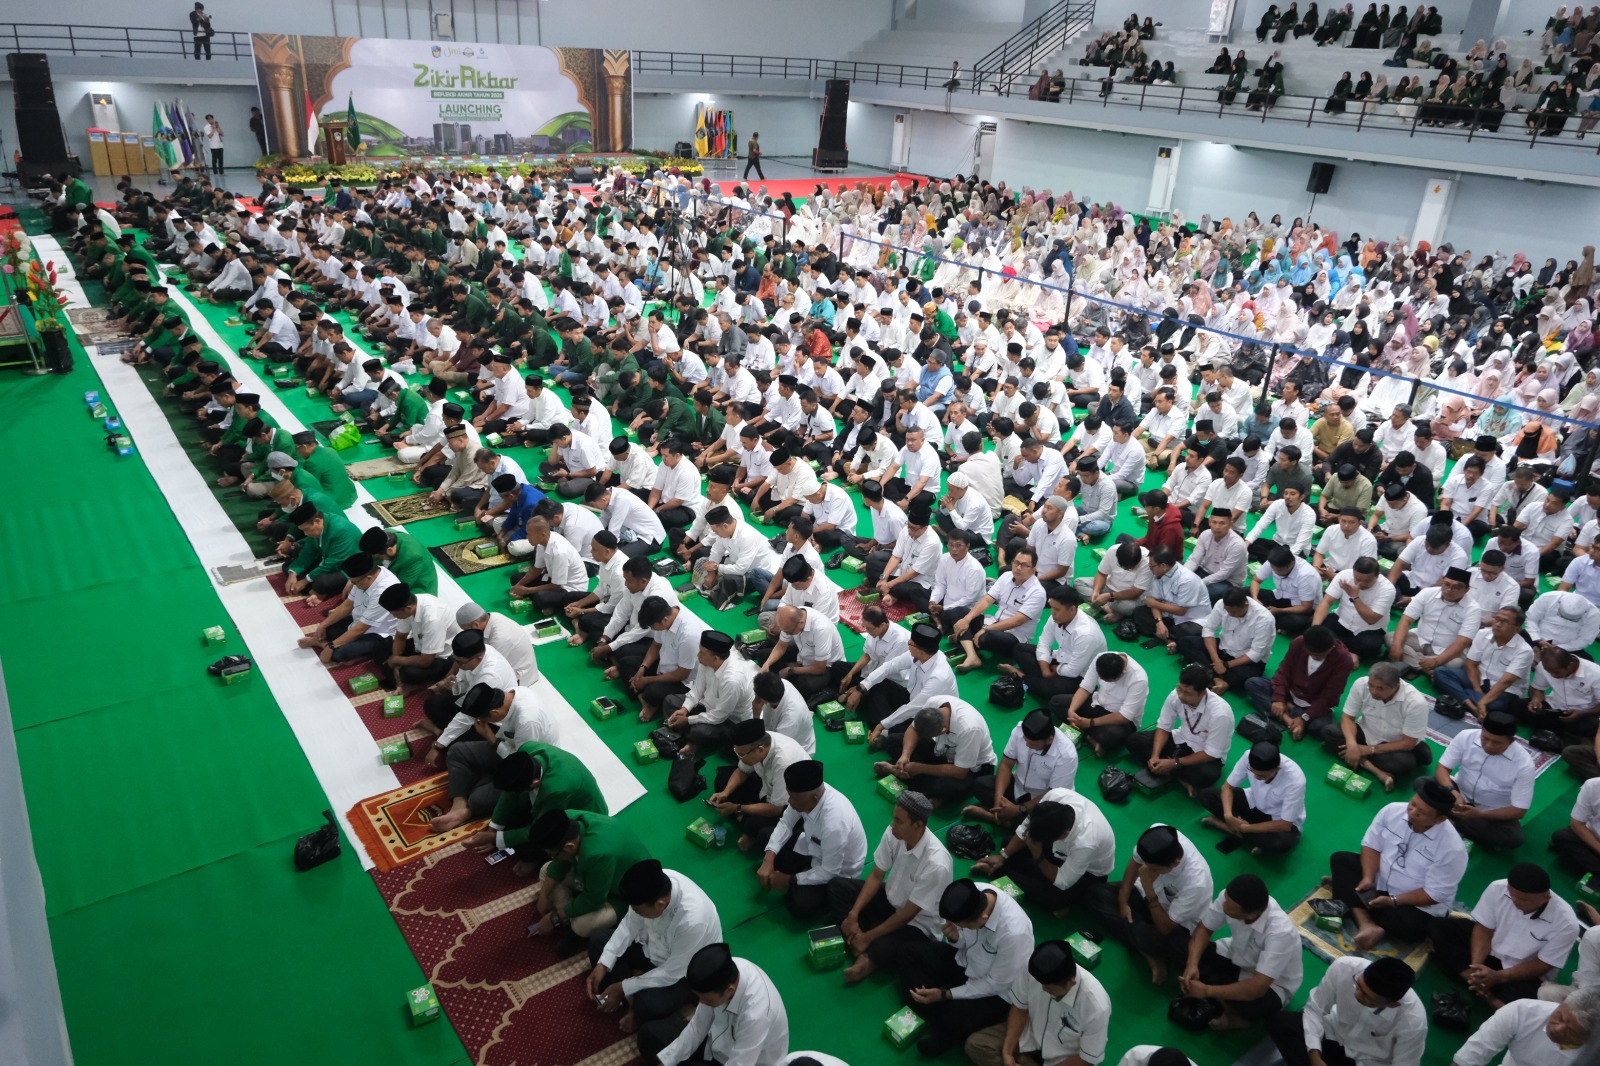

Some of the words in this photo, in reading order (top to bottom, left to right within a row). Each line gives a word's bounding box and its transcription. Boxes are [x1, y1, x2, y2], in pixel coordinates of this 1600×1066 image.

[413, 62, 459, 88] Zikir
[459, 64, 518, 89] Akbar
[439, 103, 502, 114] LAUNCHING
